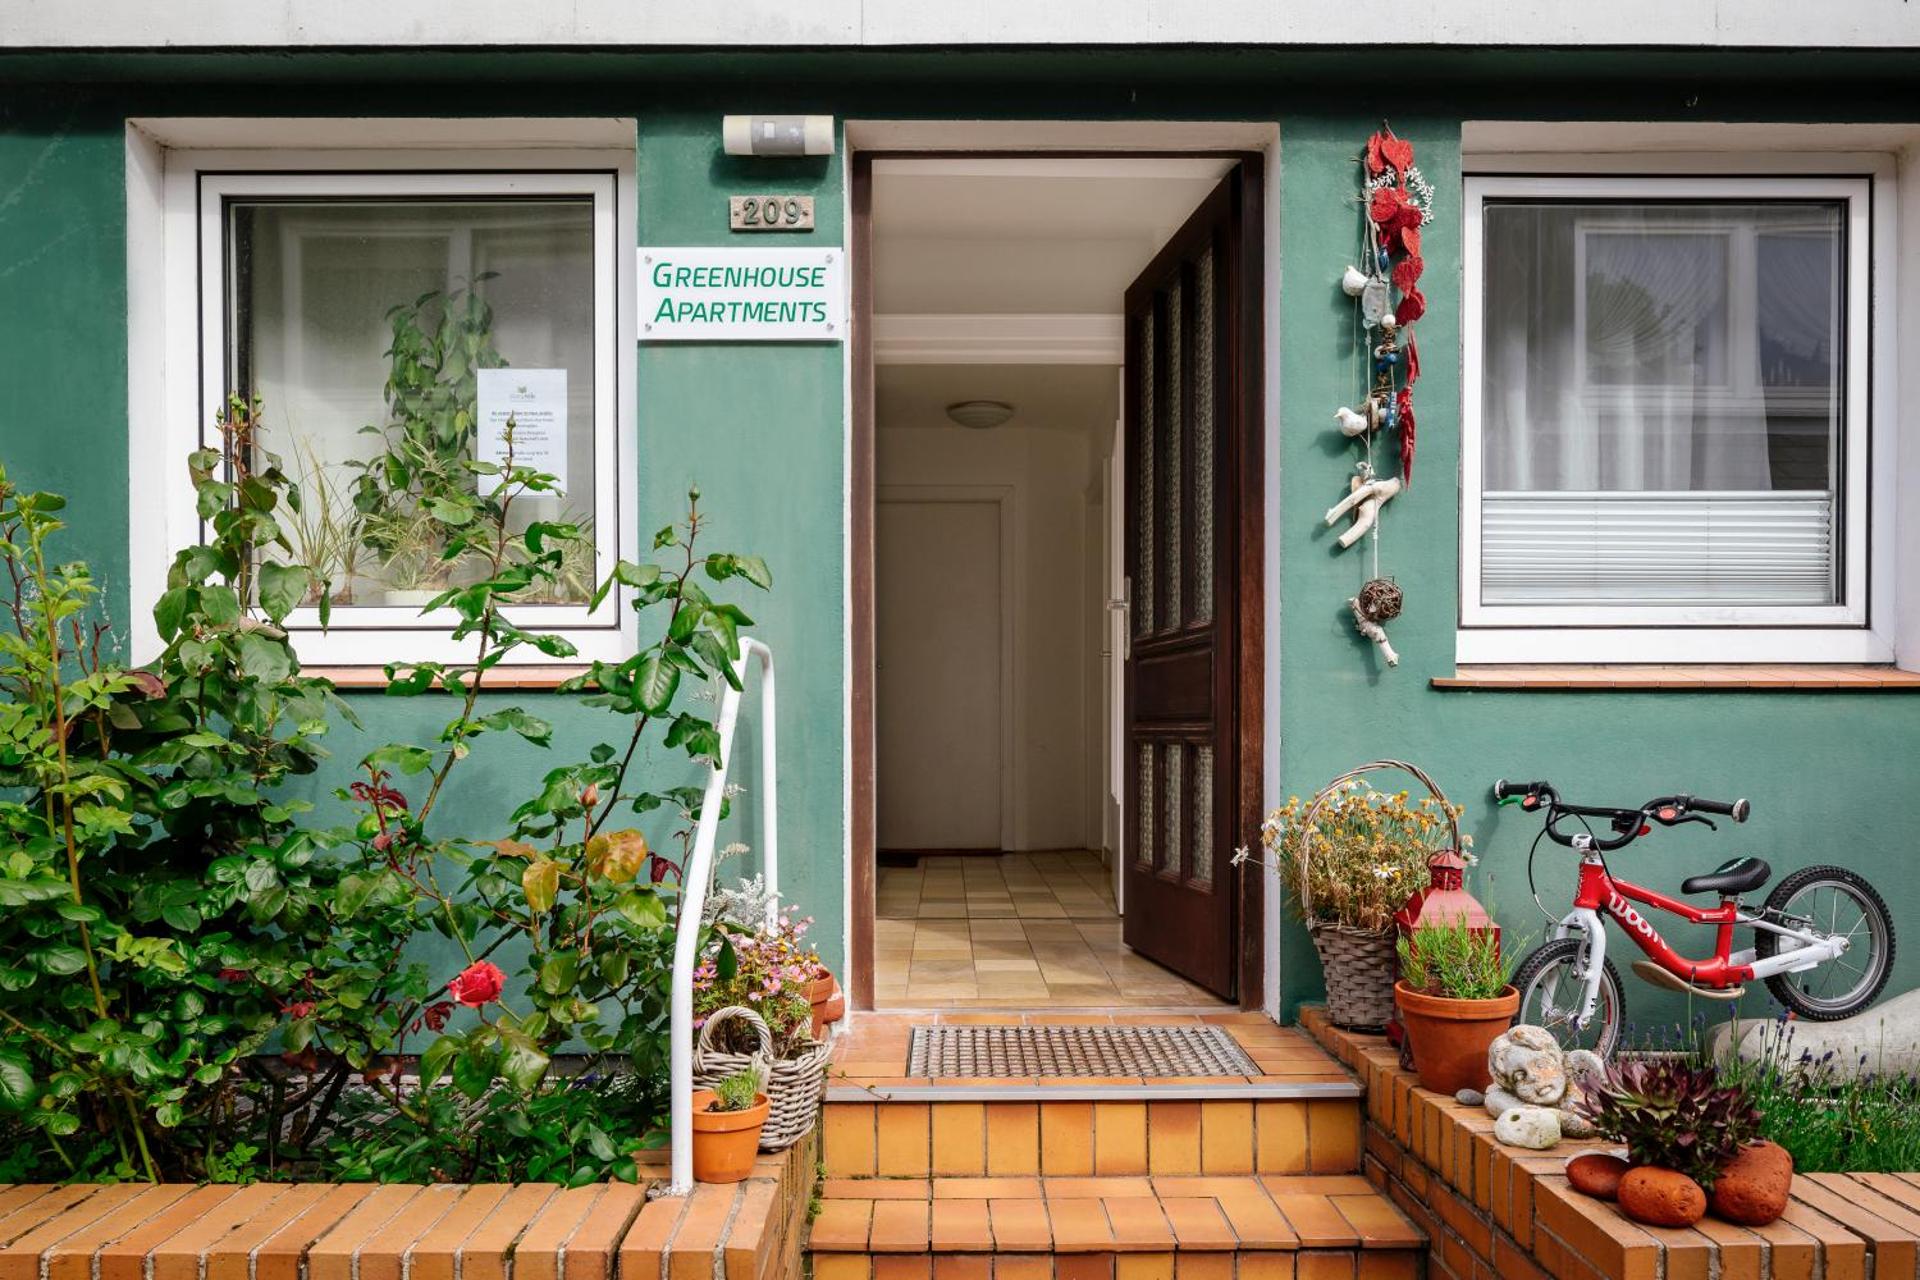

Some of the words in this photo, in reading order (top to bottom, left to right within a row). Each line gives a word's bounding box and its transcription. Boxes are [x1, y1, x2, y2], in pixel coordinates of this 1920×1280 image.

[743, 198, 801, 225] 209
[653, 262, 827, 288] GREENHOUSE
[654, 297, 827, 323] APARTMENTS
